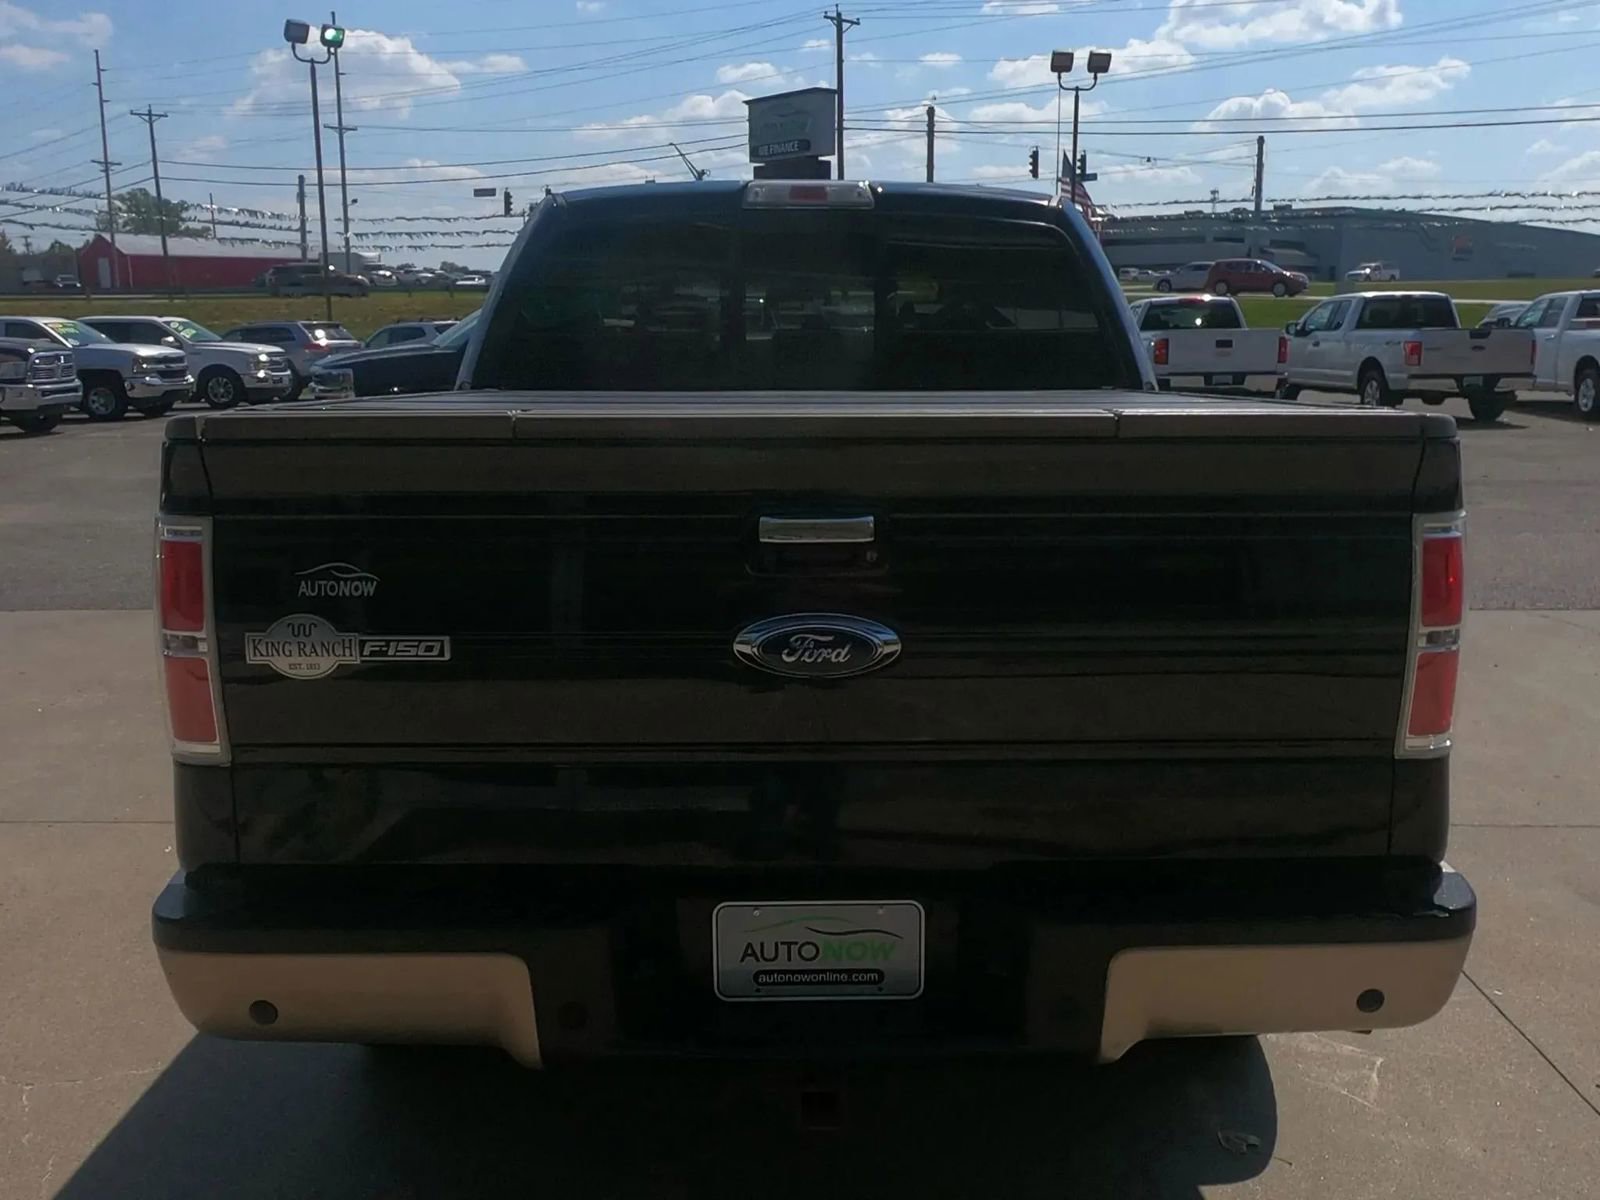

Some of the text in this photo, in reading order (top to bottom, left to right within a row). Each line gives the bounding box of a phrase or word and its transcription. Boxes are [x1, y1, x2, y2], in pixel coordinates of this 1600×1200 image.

[770, 141, 800, 155] FINANCE
[298, 580, 377, 597] AUTONOW
[252, 638, 353, 658] KING RANCH
[363, 641, 441, 656] F-150
[781, 634, 851, 662] Ford
[758, 973, 879, 983] autonowonline.com
